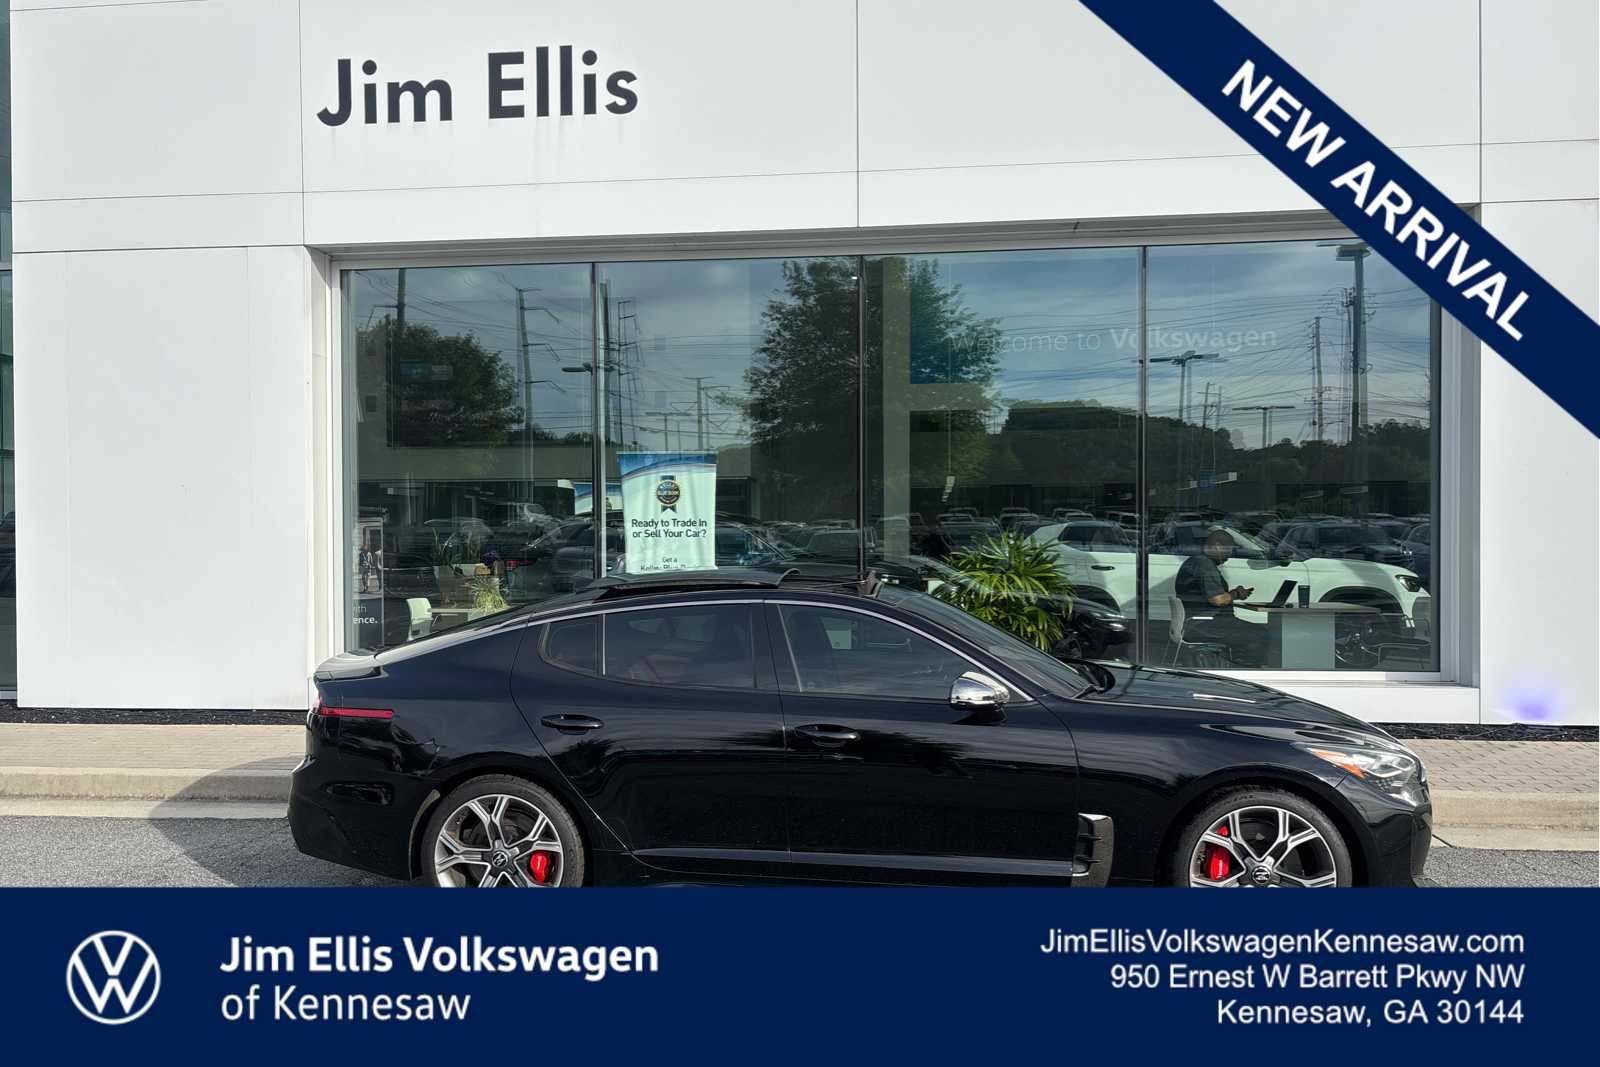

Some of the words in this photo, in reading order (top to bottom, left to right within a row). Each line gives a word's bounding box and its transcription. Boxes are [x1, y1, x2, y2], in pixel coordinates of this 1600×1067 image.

[317, 59, 452, 127] Jim
[487, 45, 638, 119] Ellis
[952, 331, 1069, 352] Welcome
[1077, 331, 1100, 351] to
[631, 518, 659, 529] Ready
[661, 519, 669, 527] to
[672, 518, 697, 527] Trade
[632, 530, 642, 538] or
[644, 529, 660, 538] Sell
[663, 529, 683, 538] Your
[686, 529, 707, 538] Car?
